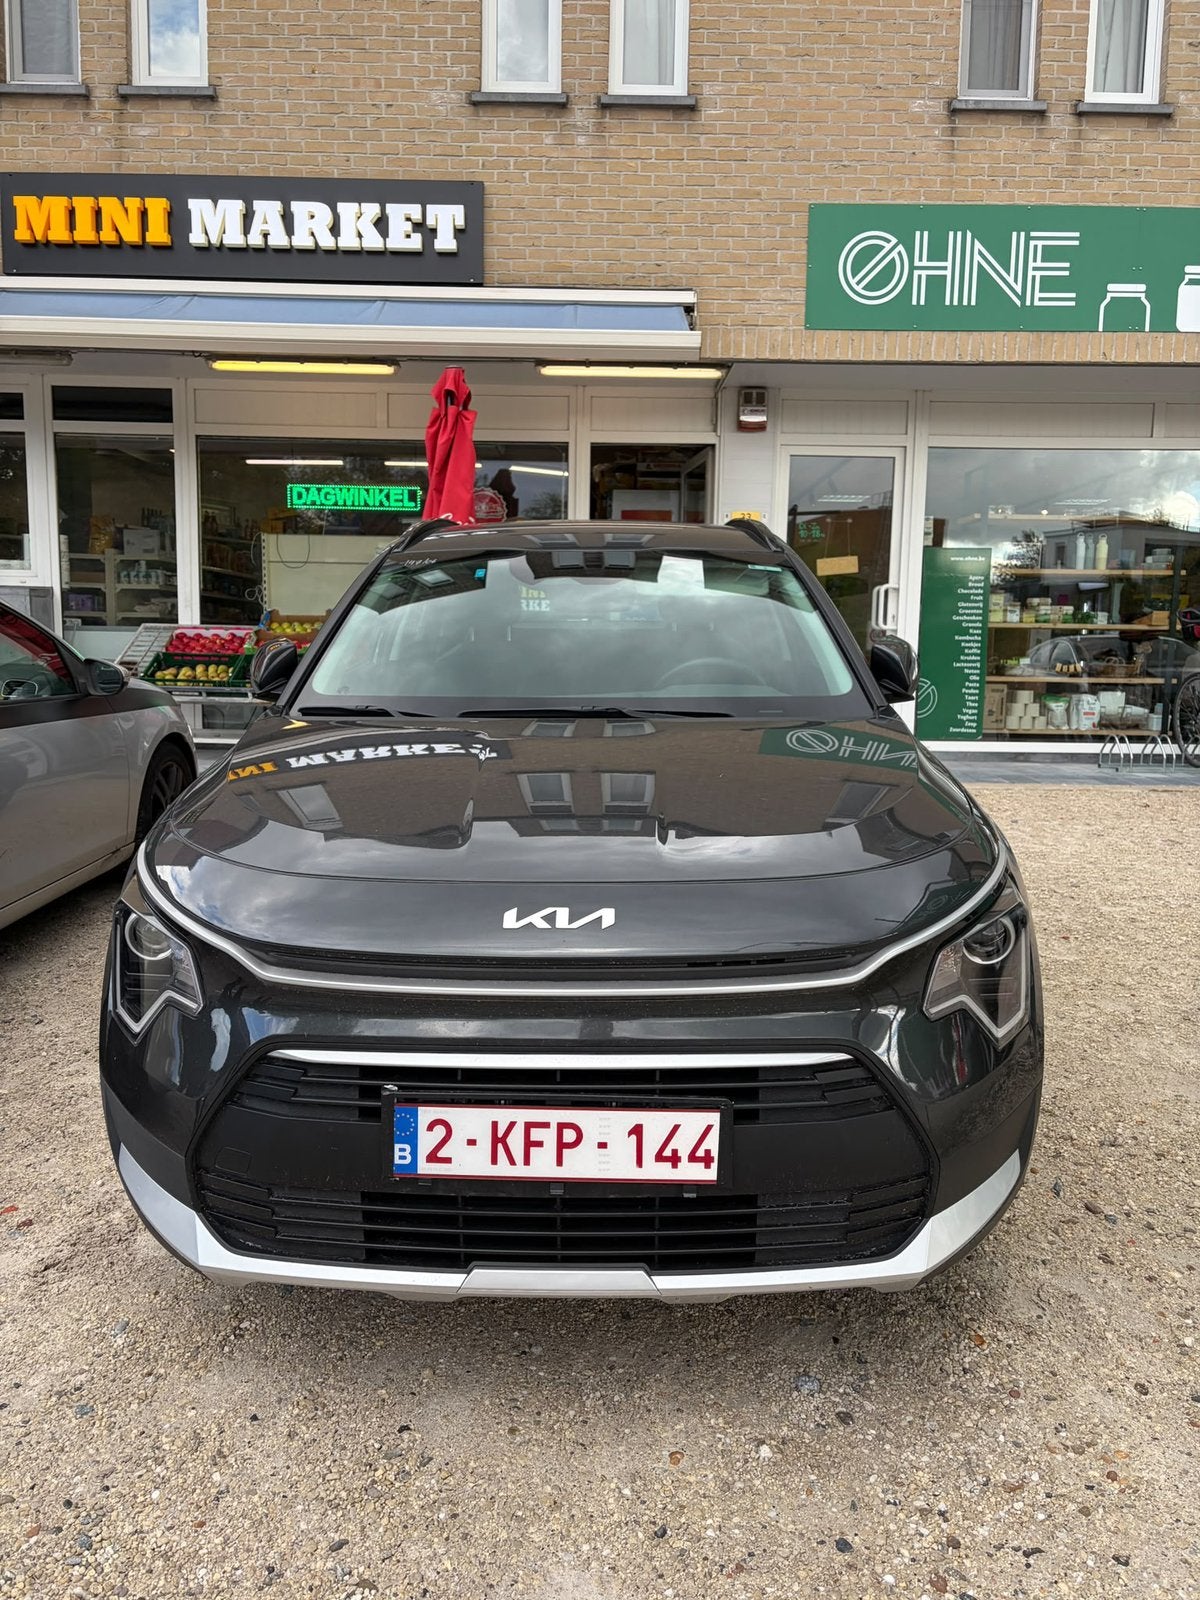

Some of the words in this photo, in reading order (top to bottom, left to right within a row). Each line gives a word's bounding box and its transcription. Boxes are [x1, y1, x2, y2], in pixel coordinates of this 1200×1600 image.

[13, 195, 172, 246] MINI
[187, 198, 466, 253] MARKET
[291, 487, 416, 507] DAGWINKEL
[502, 906, 616, 930] KIA
[394, 1143, 412, 1165] B
